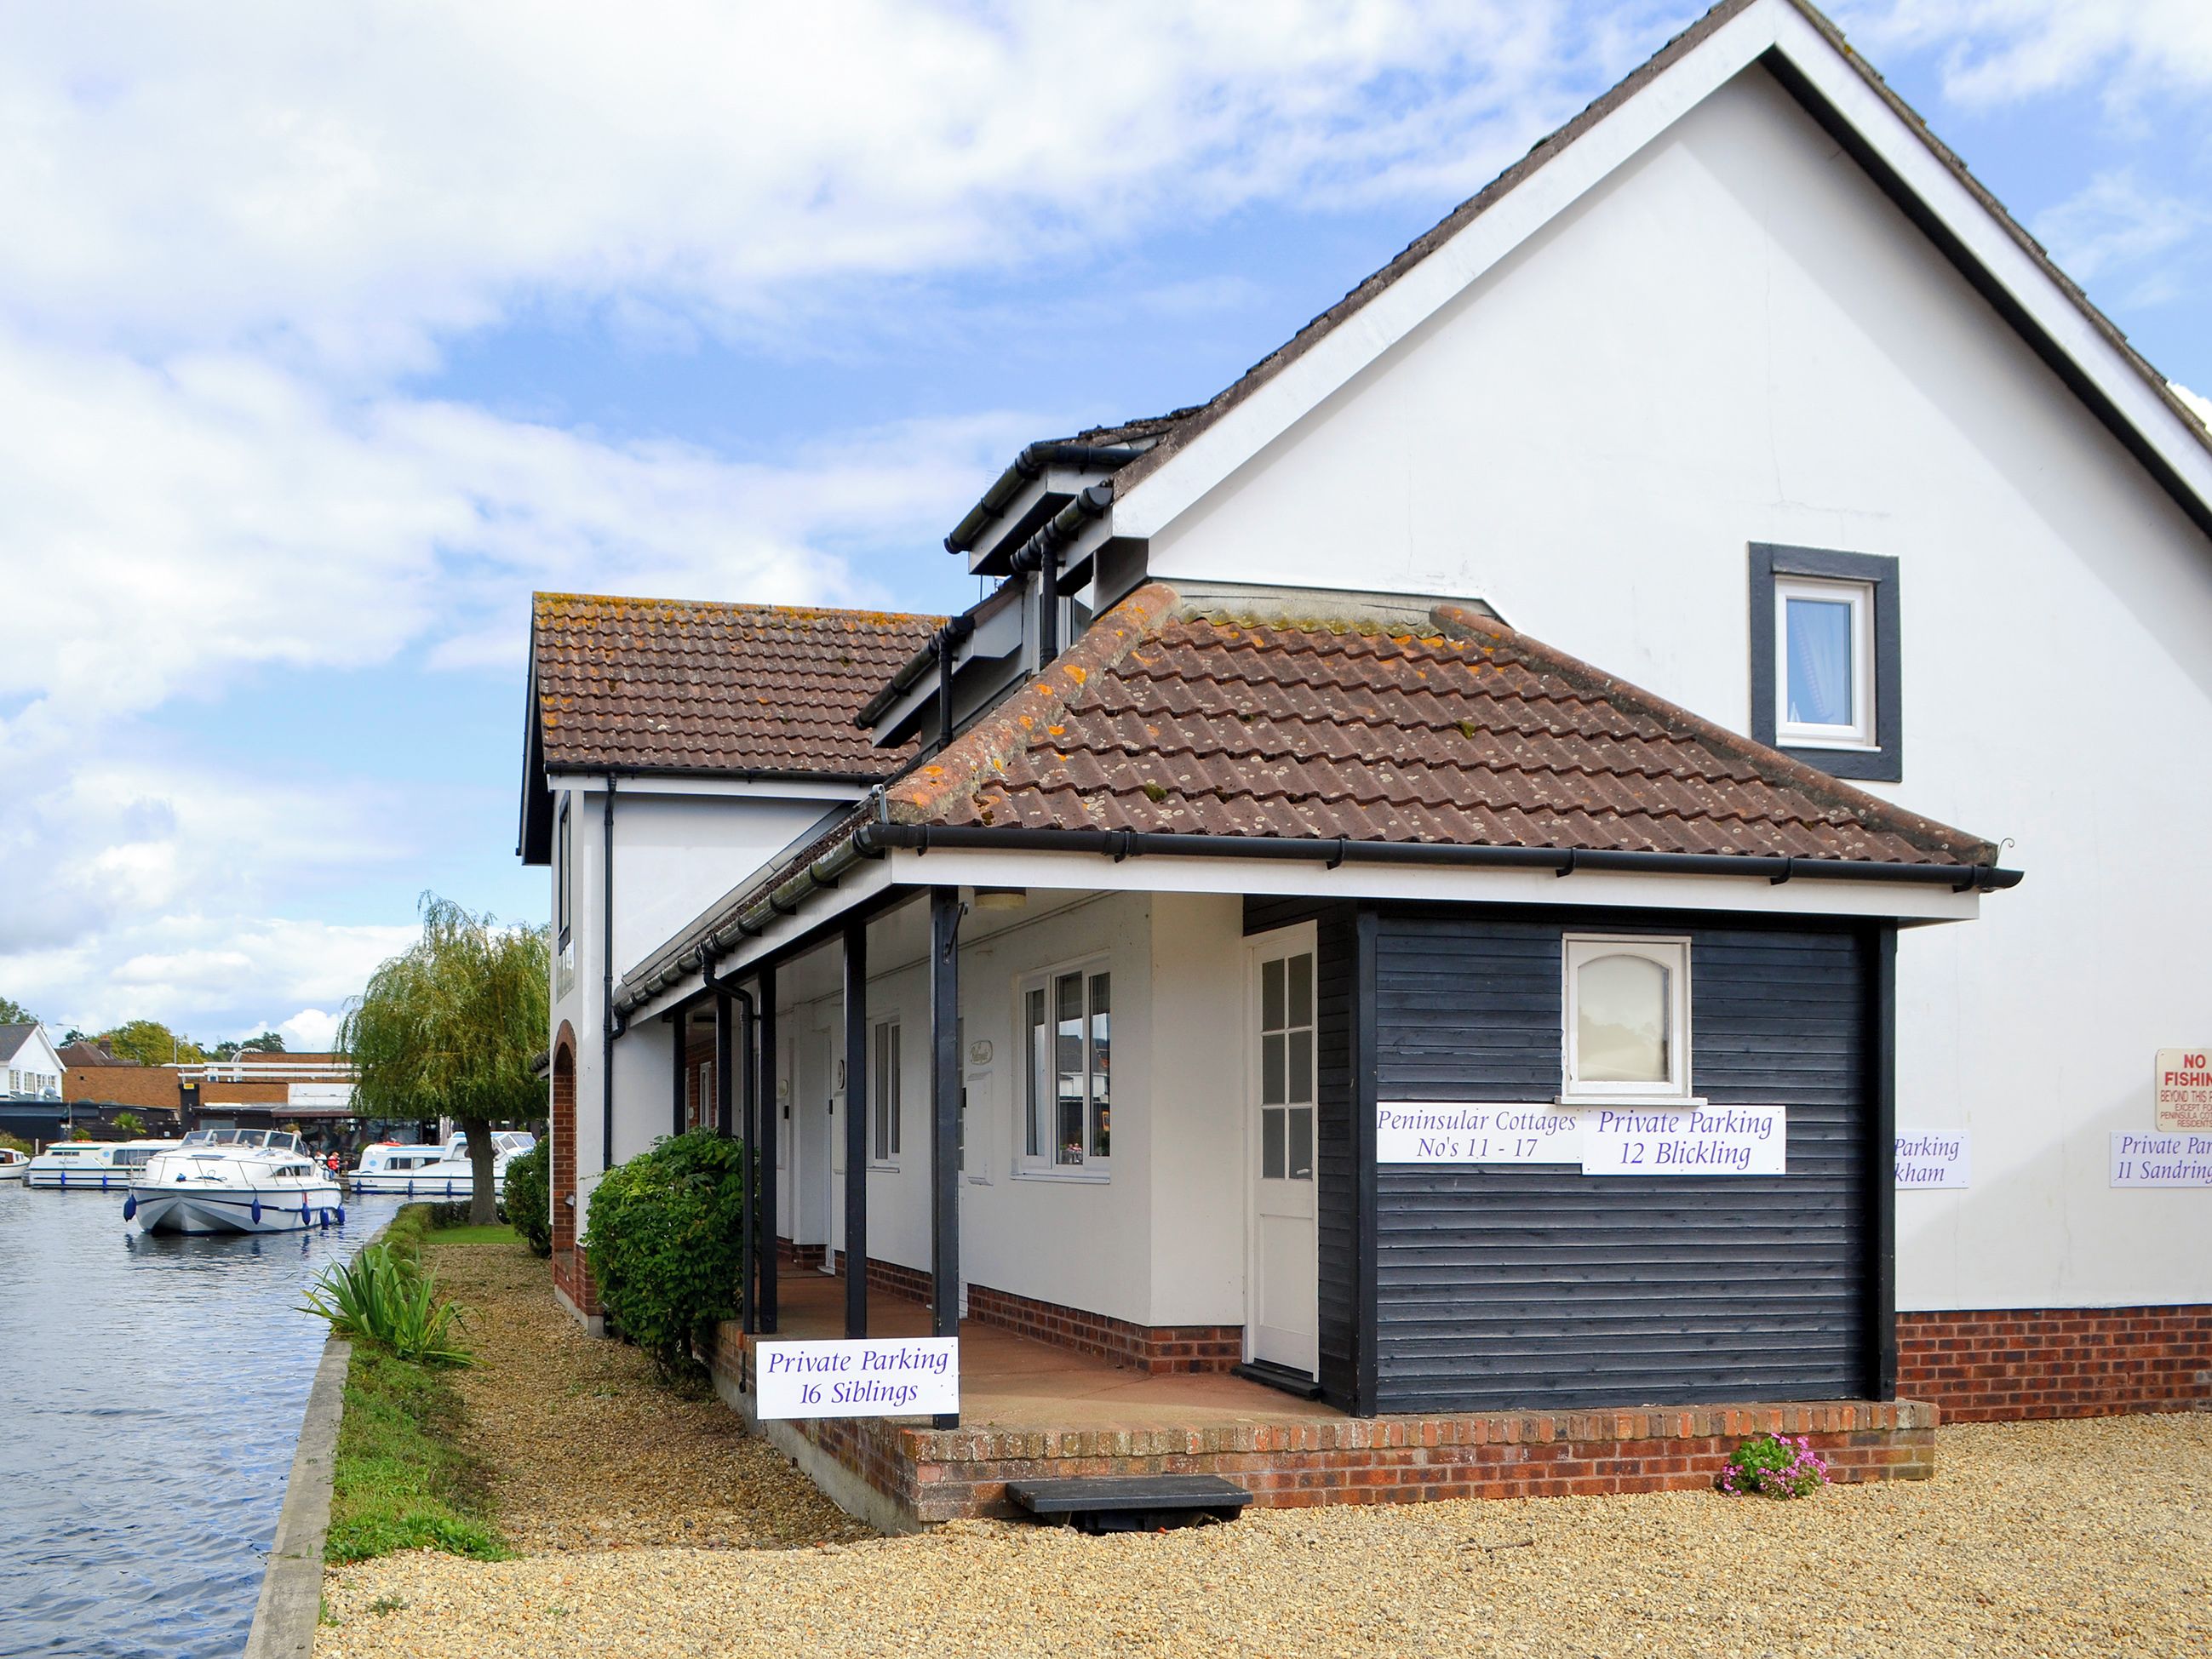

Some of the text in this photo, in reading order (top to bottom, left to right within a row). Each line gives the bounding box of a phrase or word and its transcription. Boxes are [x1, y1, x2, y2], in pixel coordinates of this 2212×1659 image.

[2184, 1054, 2206, 1068] NO
[2160, 1090, 2188, 1102] BEYOND
[2191, 1090, 2207, 1102] THIS
[2175, 1103, 2200, 1112] EXCEPT
[1377, 1109, 1576, 1136] Peninsular Cottages
[1597, 1109, 1773, 1140] Private Parking
[1417, 1136, 1458, 1157] No's
[1467, 1138, 1487, 1157] 11
[1514, 1138, 1538, 1157] 17
[1619, 1141, 1751, 1170] 12 Blickling
[1894, 1136, 1959, 1161] Parking
[2121, 1136, 2180, 1154] Private
[2118, 1161, 2132, 1179] 11
[768, 1347, 948, 1375] Private Parking
[799, 1380, 918, 1407] 16 Siblings
